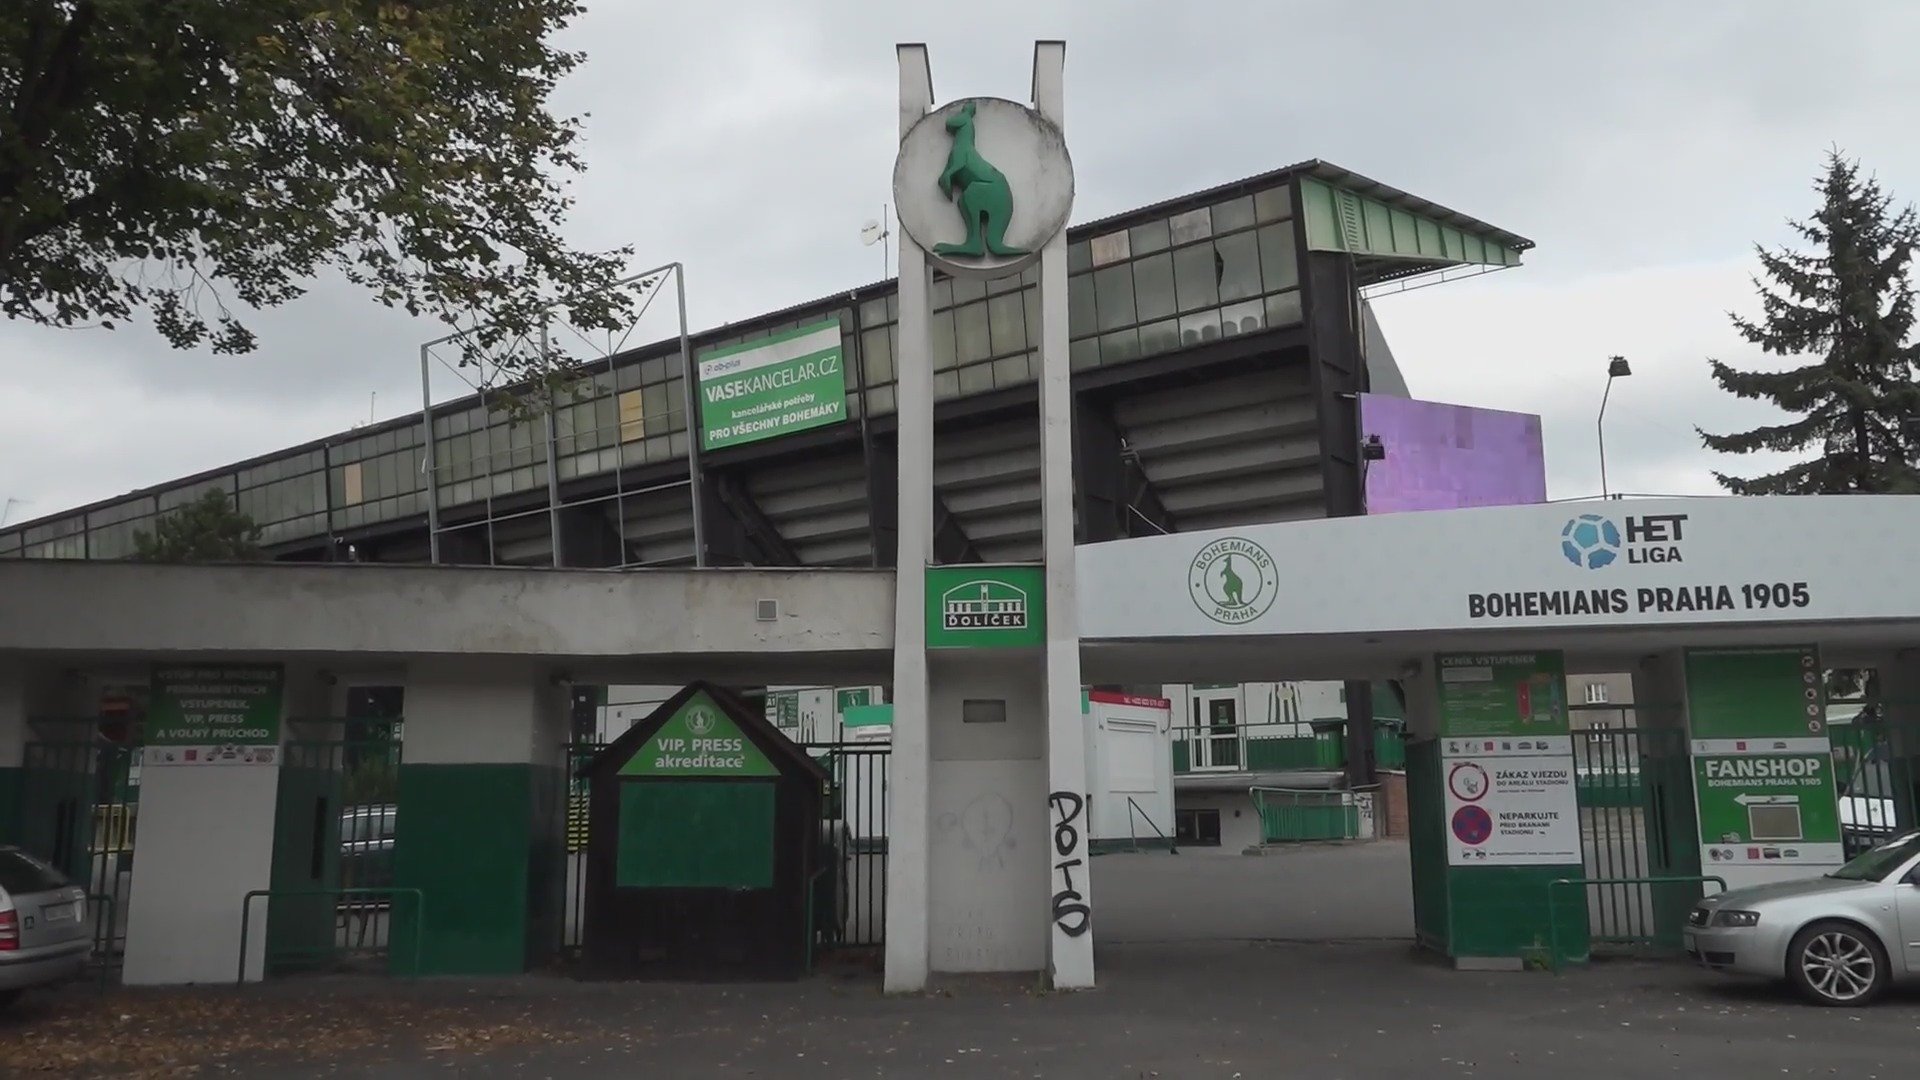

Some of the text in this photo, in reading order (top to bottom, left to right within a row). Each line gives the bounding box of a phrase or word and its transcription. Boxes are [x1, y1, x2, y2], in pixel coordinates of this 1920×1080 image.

[706, 356, 838, 402] VASEKANCELAR.CZ
[710, 402, 839, 441] PRO VŠECHNY BOHEMÁKY
[1626, 514, 1688, 542] HET
[1196, 541, 1269, 570] BOHEMIANS
[1627, 547, 1683, 564] LIGA
[1469, 582, 1810, 618] BOHEMIANS PRAHA 1905
[1214, 606, 1258, 620] PRAHA
[208, 713, 245, 724] PRESS
[156, 727, 269, 738] A VOLNÝ PRŮCHOD
[657, 738, 742, 753] VIP, PRESS
[1496, 769, 1567, 779] ZÁKAZ VJEZDU
[1705, 758, 1821, 777] FANSHOP
[1708, 777, 1821, 787] BOHEMIANS PRAHA 1905
[1499, 812, 1559, 820] NEPARKUJTE
